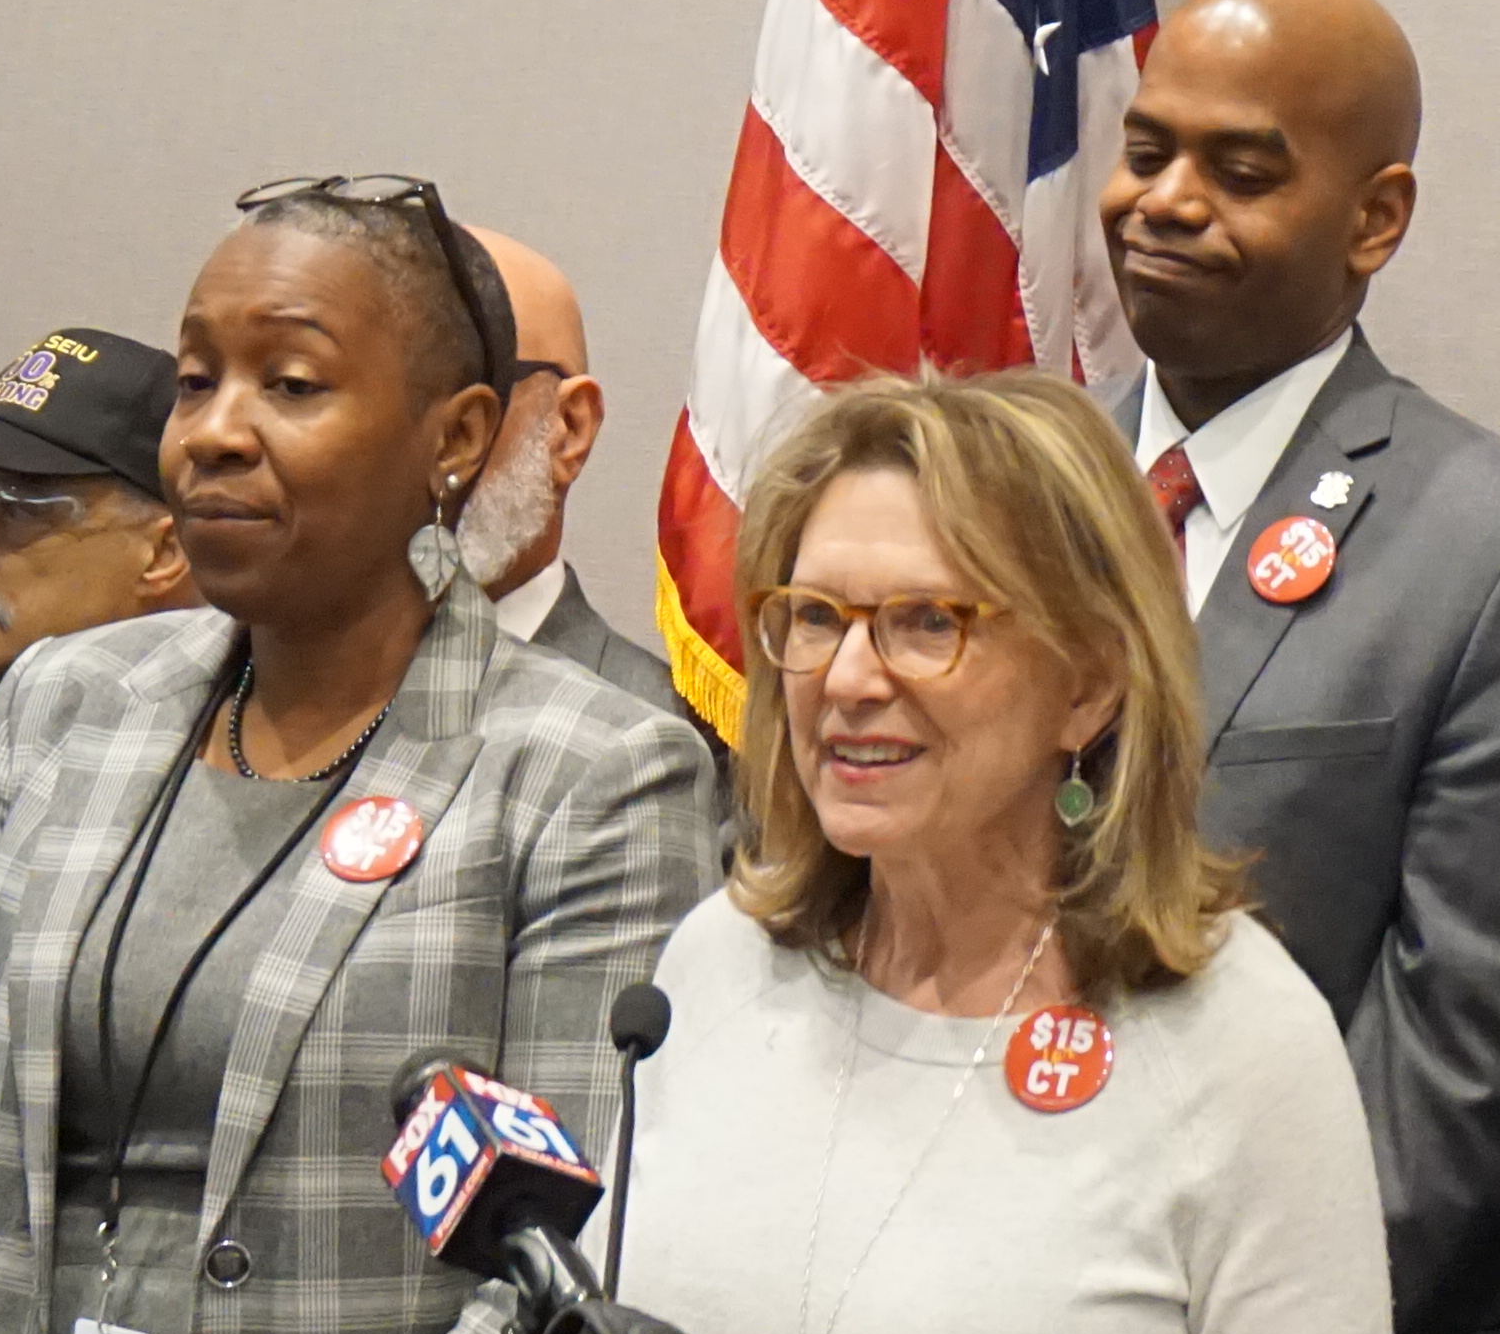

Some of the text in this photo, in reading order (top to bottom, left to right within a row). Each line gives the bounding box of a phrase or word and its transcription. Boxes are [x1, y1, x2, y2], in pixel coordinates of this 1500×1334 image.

[44, 335, 99, 362] SEIU
[1280, 520, 1329, 568] $15
[1254, 551, 1297, 589] CT
[1030, 1011, 1097, 1054] $15
[463, 1070, 546, 1117] FOX
[1026, 1059, 1080, 1098] CT
[388, 1085, 447, 1176] FOX
[492, 1101, 580, 1165] 61
[416, 1106, 480, 1216] 61
